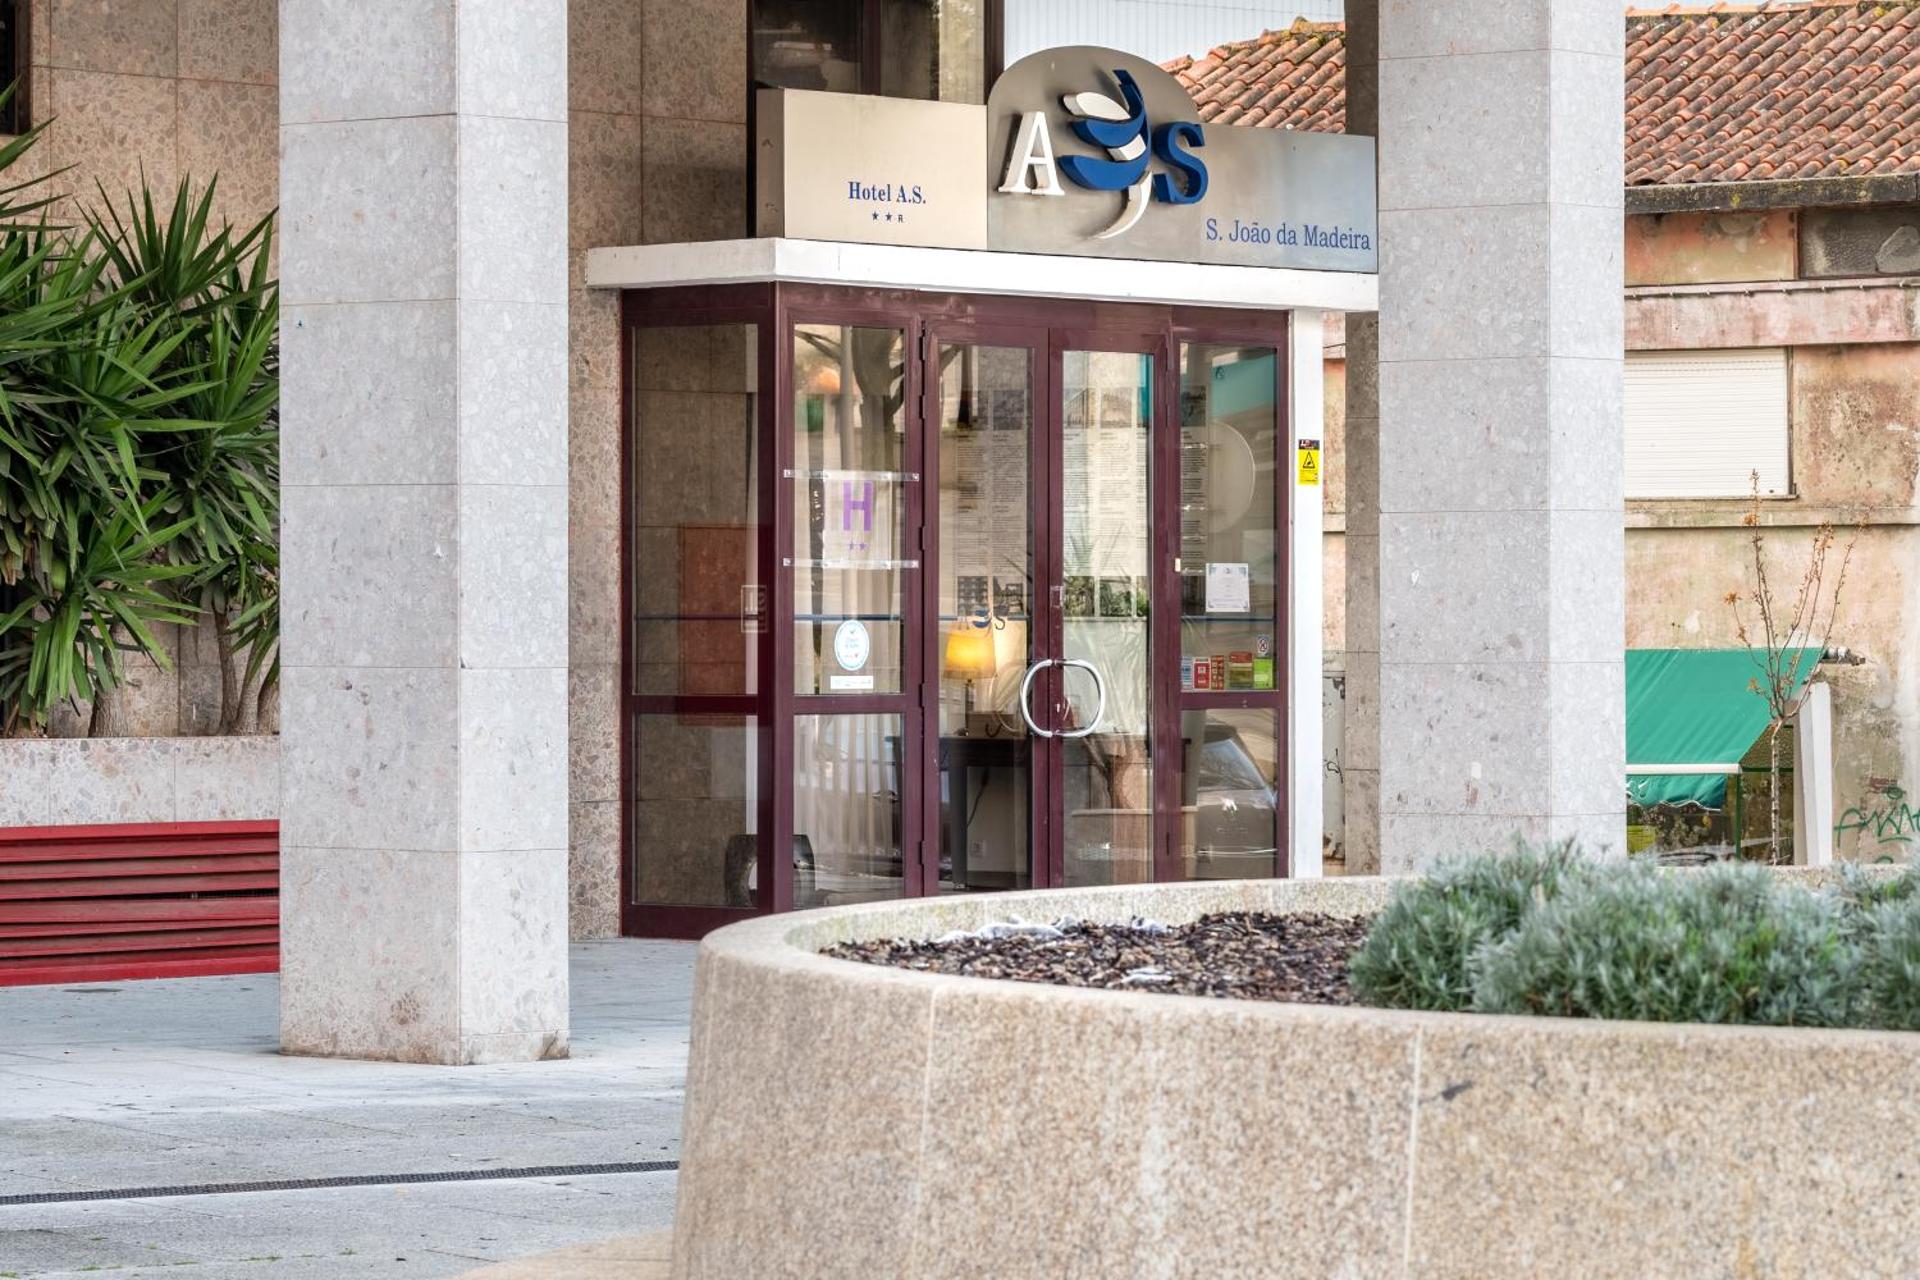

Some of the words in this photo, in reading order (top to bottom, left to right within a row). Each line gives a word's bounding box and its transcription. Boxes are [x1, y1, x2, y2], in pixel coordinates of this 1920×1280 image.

[847, 181, 892, 202] Hotel
[897, 184, 927, 205] A.S.
[1206, 218, 1223, 241] S.
[1229, 218, 1271, 244] João
[1276, 222, 1298, 246] da
[1303, 224, 1371, 250] Madeira
[843, 481, 872, 531] H
